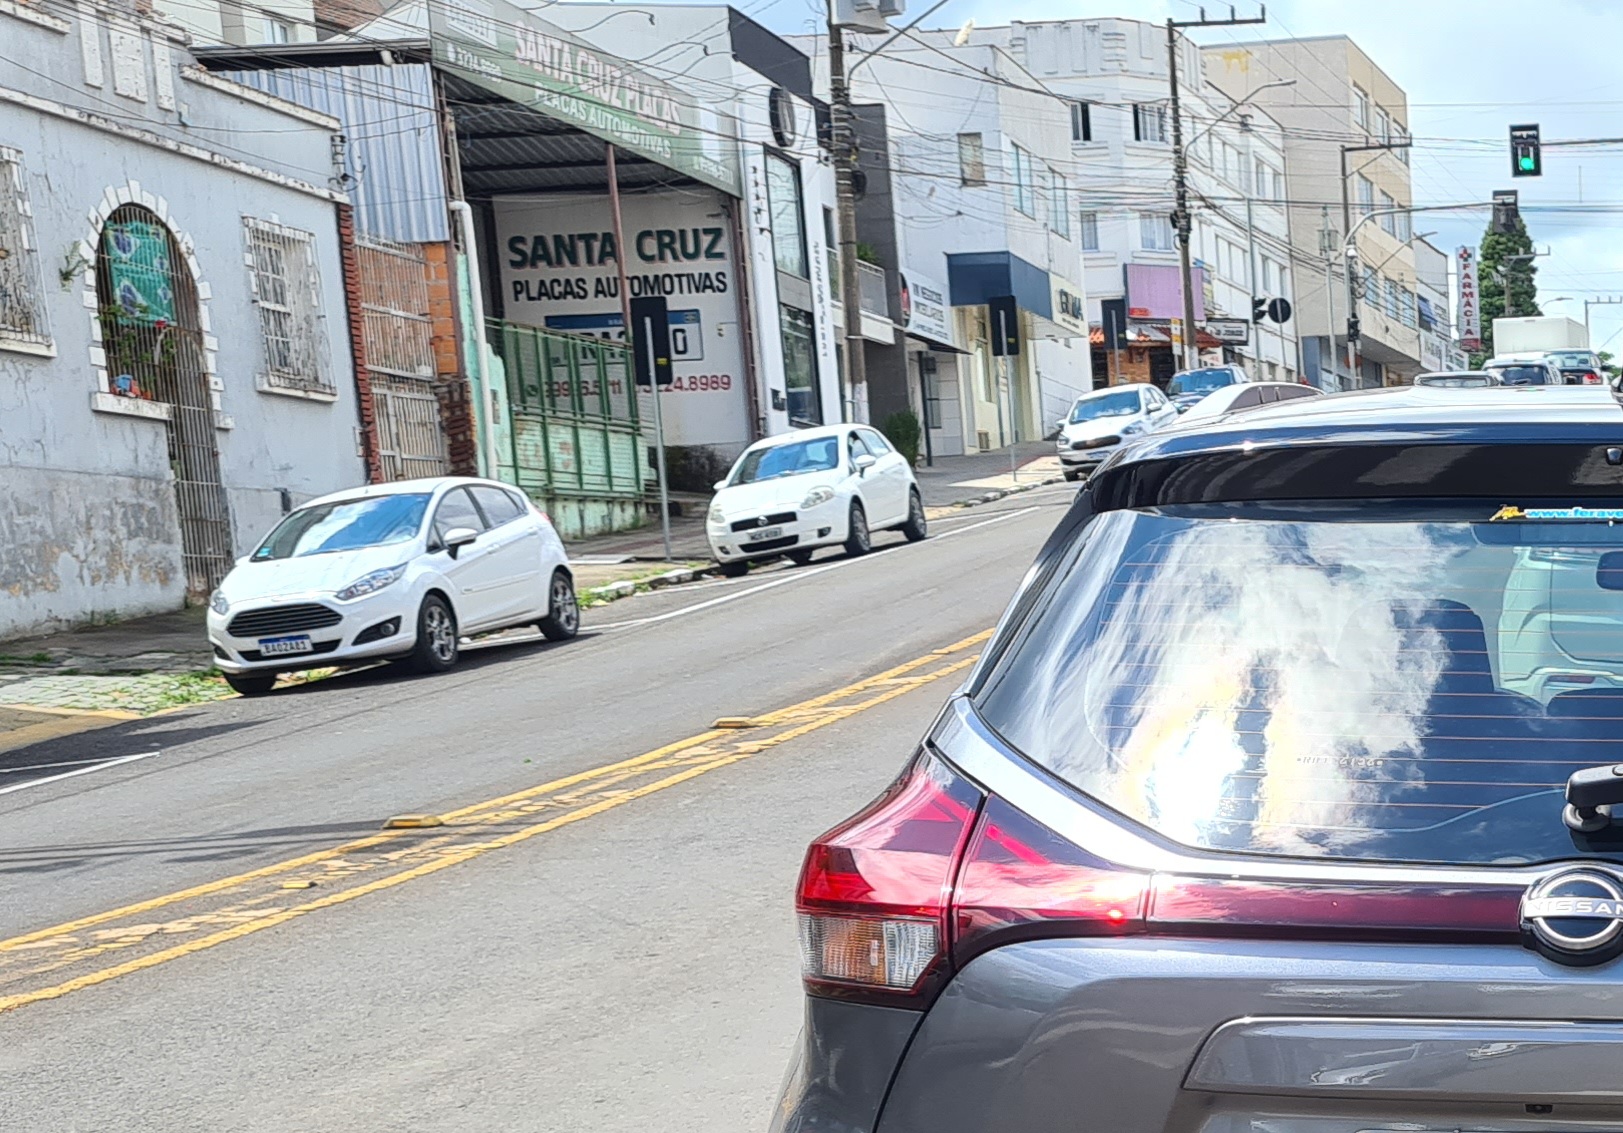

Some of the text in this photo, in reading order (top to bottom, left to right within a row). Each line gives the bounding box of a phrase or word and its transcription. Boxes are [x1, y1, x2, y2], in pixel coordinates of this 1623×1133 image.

[516, 20, 573, 85] SANTA
[577, 48, 621, 108] CRUZ
[624, 75, 681, 135] PLACAS
[535, 82, 671, 158] PLACAS AUTOMOTIVAS
[508, 227, 727, 270] SANTA CRUZ
[512, 278, 588, 302] PLACAS
